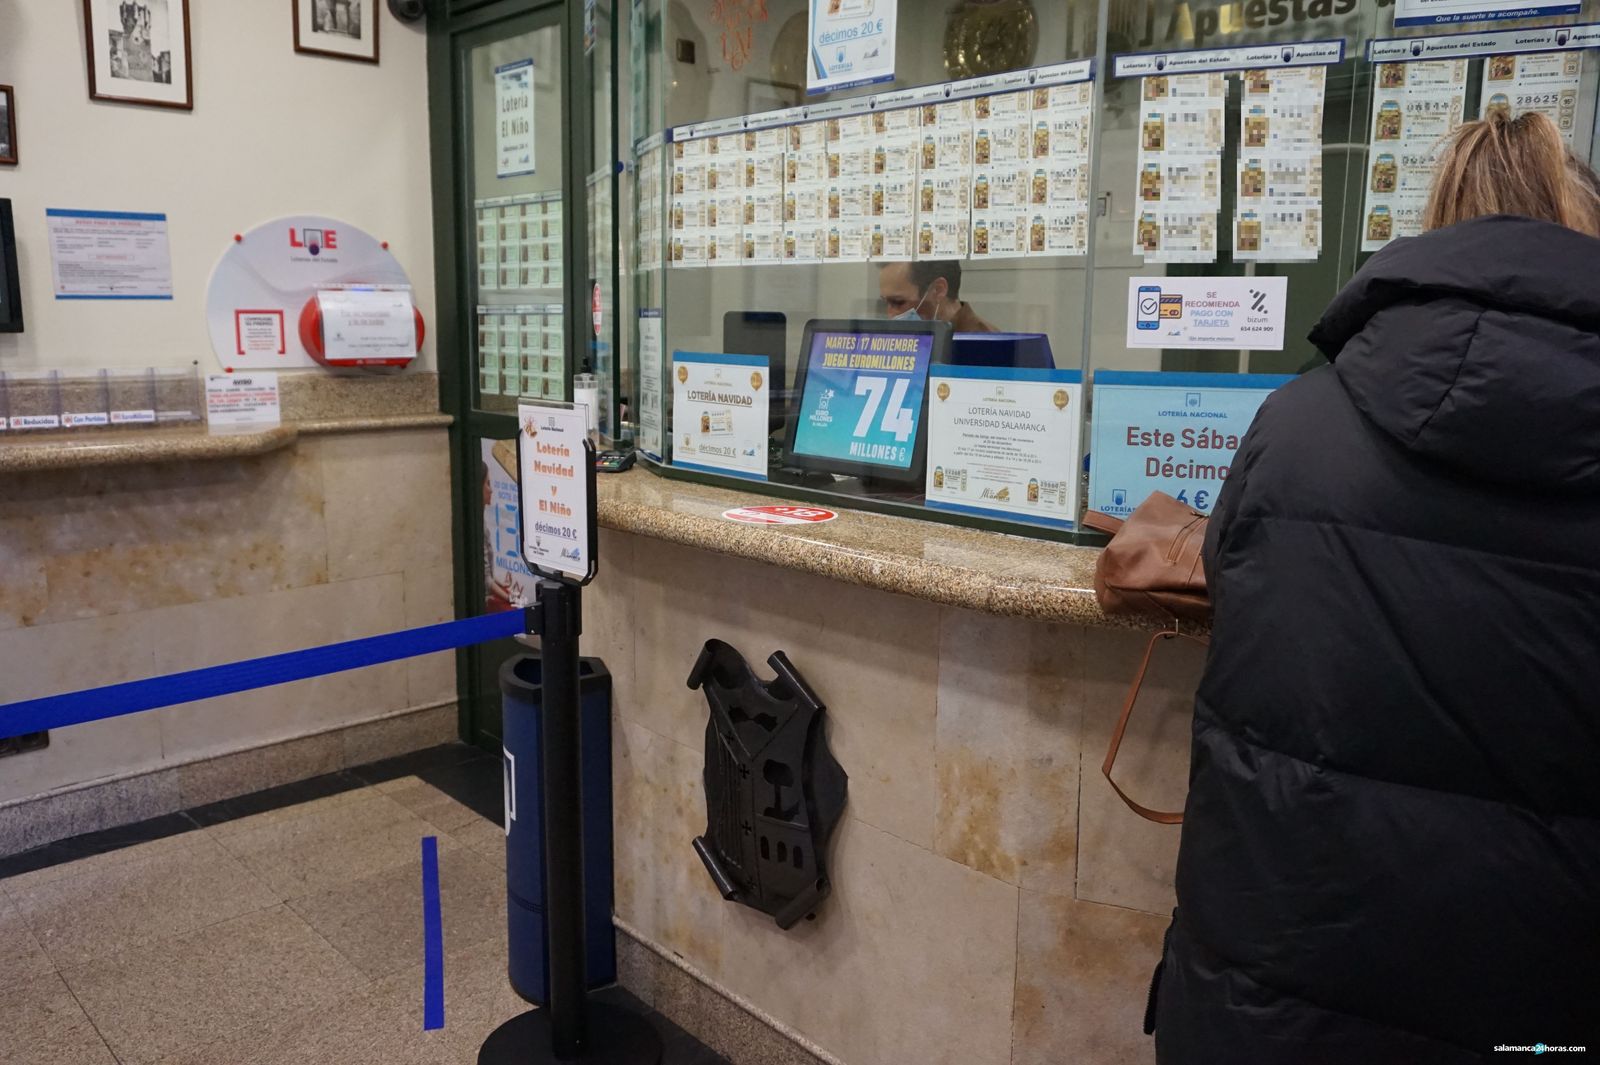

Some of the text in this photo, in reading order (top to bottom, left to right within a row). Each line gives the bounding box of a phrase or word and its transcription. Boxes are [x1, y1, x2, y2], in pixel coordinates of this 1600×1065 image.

[819, 18, 884, 44] décimos 20 €
[1426, 44, 1458, 52] Apuestas
[1515, 36, 1544, 44] Loterías
[1168, 58, 1196, 66] Apuestas
[1209, 56, 1230, 64] Estado
[1296, 50, 1328, 58] Apuestas
[502, 92, 528, 113] Lotería
[1516, 94, 1559, 105] 28625
[502, 116, 529, 138] El Niño
[1193, 319, 1230, 328] TARJETA
[825, 336, 920, 352] MARTES 17 NOVIEMBRE
[822, 353, 916, 371] JUEGA EUROMILLONES
[688, 390, 752, 406] LOTERÍA NAVIDAD
[852, 375, 914, 442] 74
[968, 407, 1031, 419] LOTERÍA NAVIDAD
[954, 417, 1046, 432] UNIVERSIDAD SALAMANCA
[1126, 426, 1246, 450] Este Sába
[536, 441, 570, 457] Lotería
[724, 446, 731, 456] 20
[850, 442, 906, 462] MILLONES €
[534, 460, 574, 478] Navidad
[552, 486, 557, 497] y
[1176, 489, 1210, 510] 6 €
[538, 500, 572, 517] El Niño
[534, 521, 577, 539] décimos 20 €
